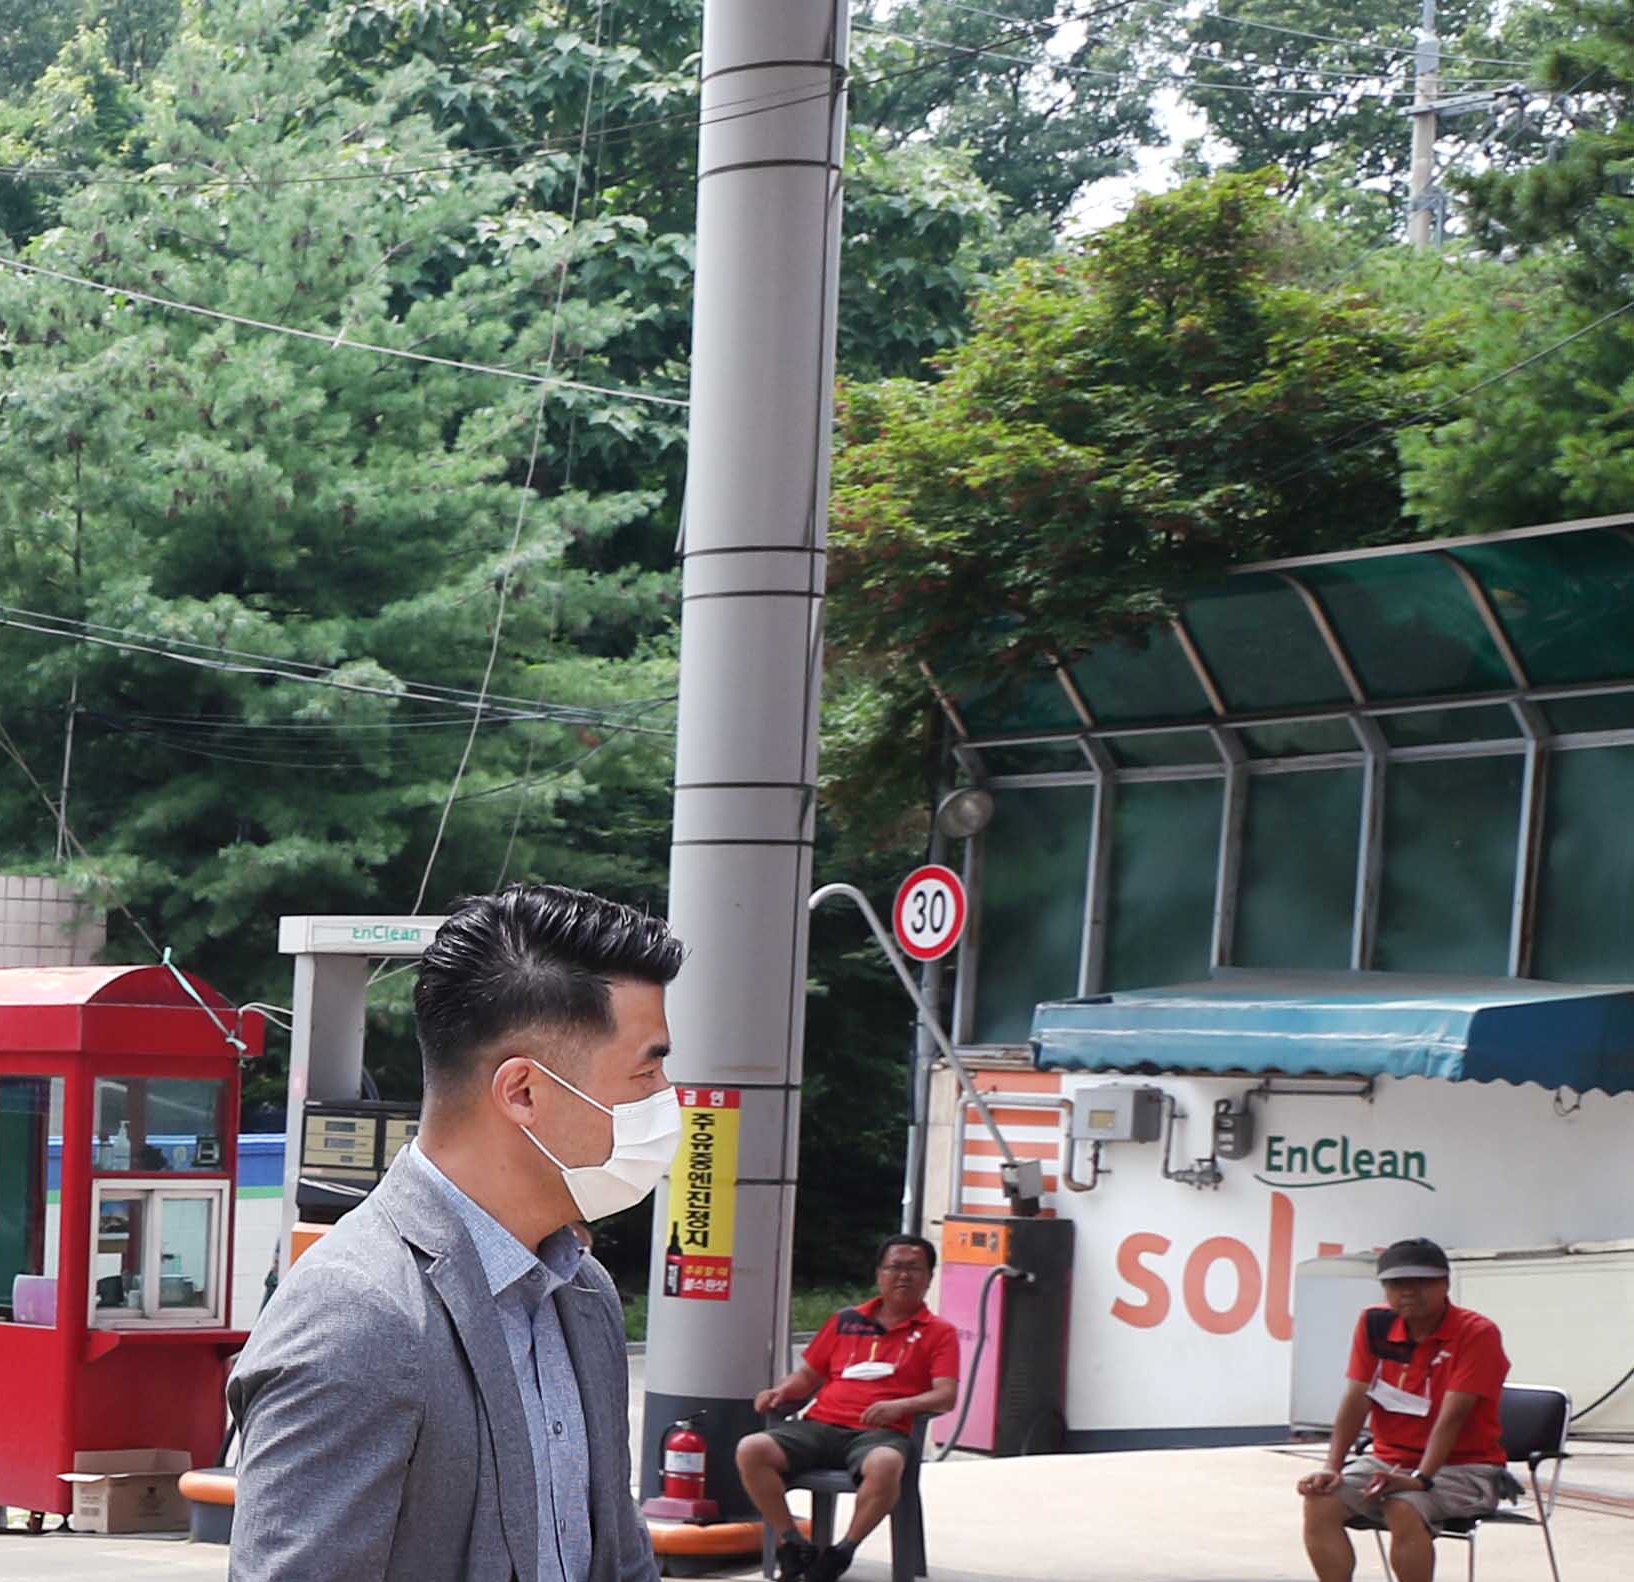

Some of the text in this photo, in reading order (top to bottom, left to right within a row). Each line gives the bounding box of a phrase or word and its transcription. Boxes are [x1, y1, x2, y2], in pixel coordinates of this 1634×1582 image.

[351, 925, 421, 941] EnClean
[911, 890, 947, 934] 30
[1265, 1136, 1427, 1180] EnClean
[684, 1112, 715, 1249] 주유중엔진정지
[1110, 1192, 1389, 1341] sol
